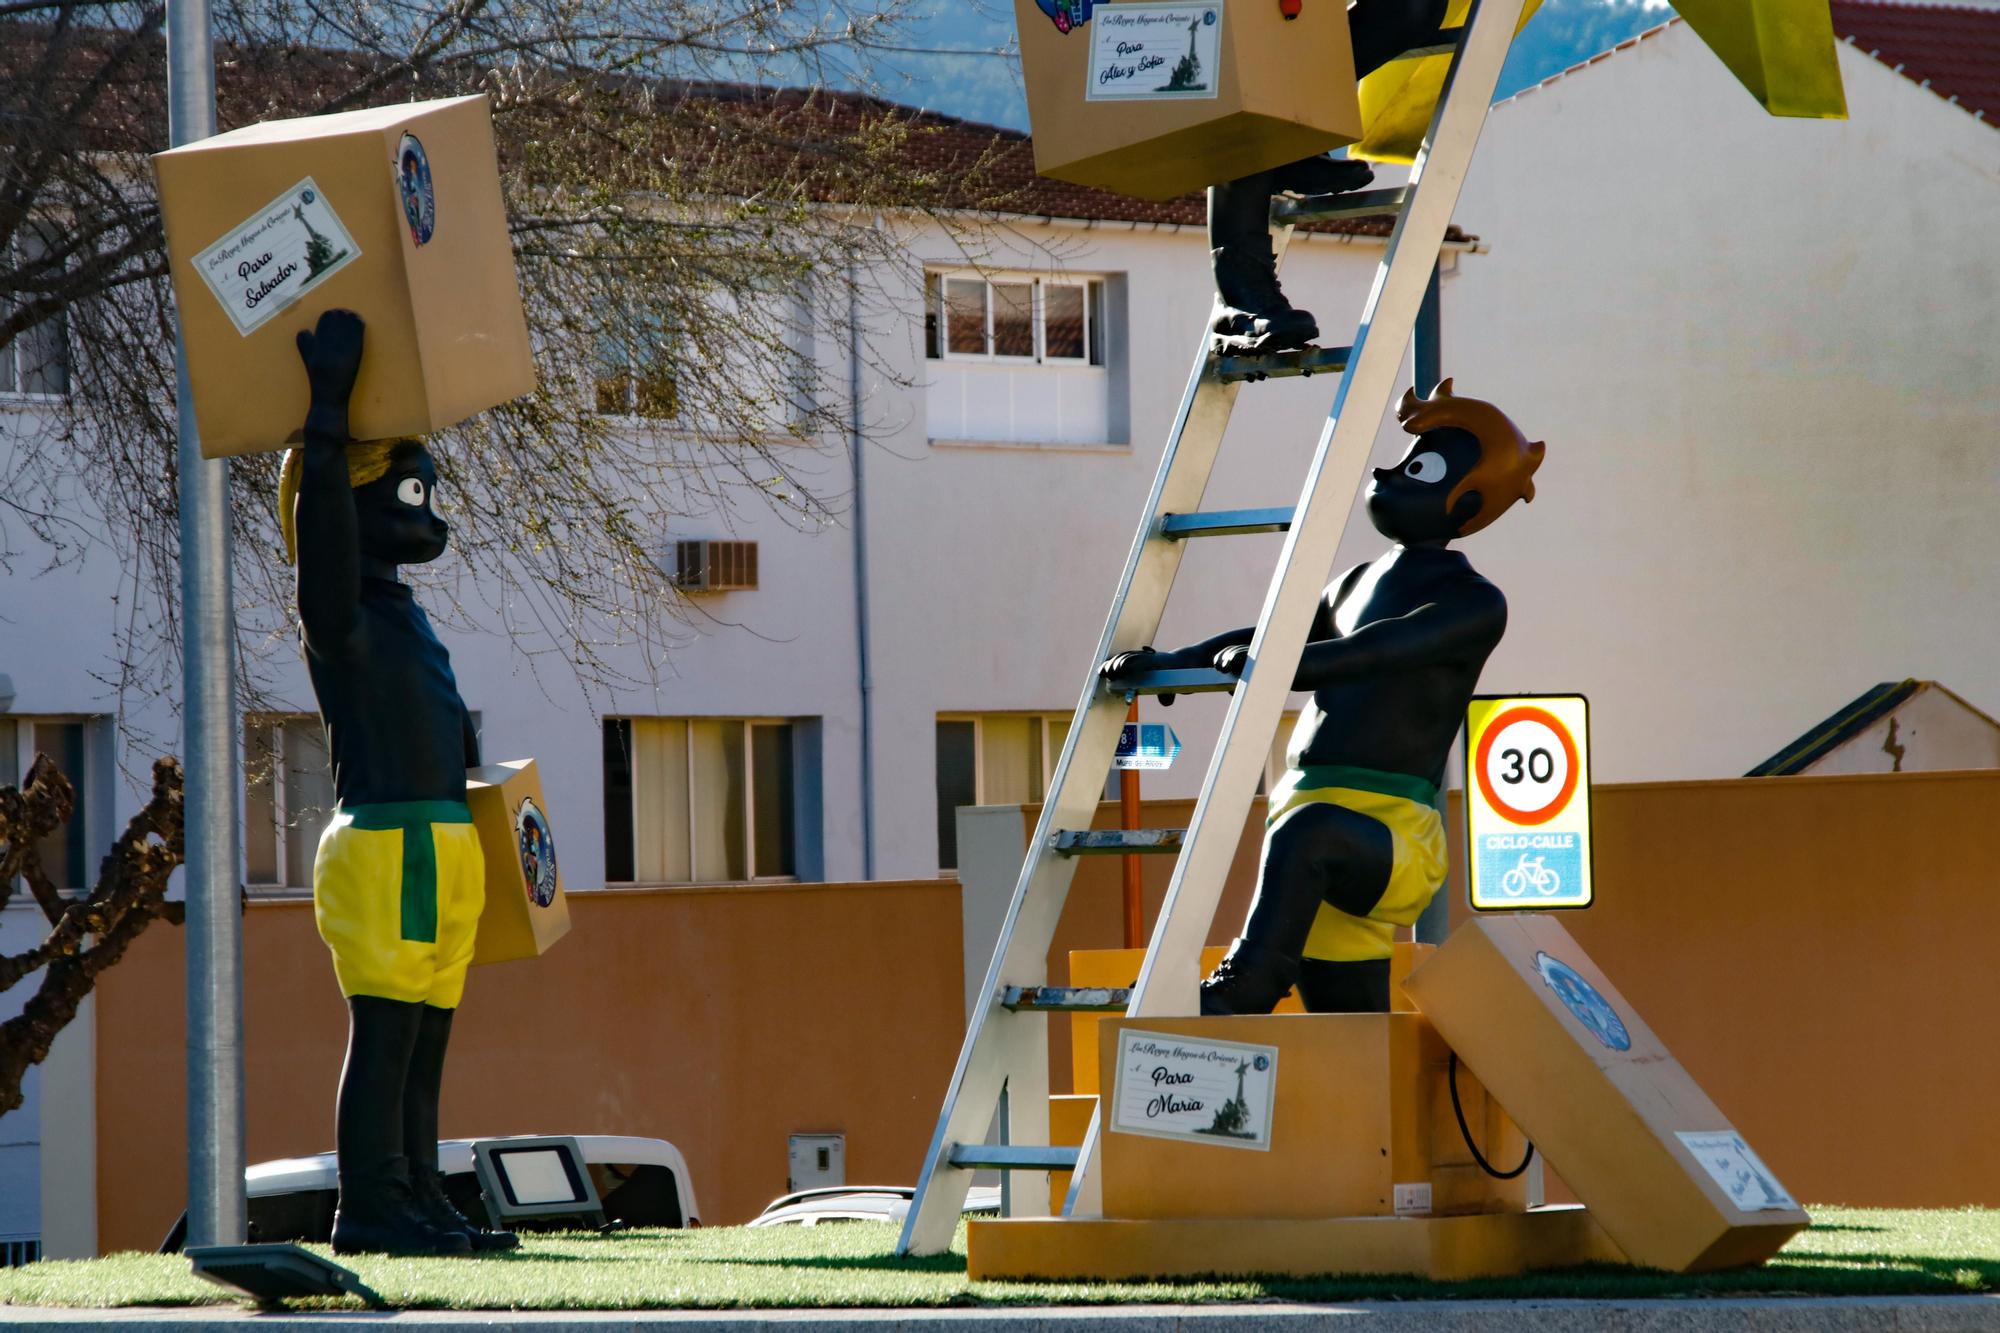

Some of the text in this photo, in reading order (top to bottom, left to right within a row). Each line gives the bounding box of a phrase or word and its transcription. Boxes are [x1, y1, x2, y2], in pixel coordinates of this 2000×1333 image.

[1116, 42, 1144, 57] Para
[1127, 65, 1136, 79] y
[238, 252, 273, 281] Para
[246, 262, 298, 309] Salvador
[1501, 747, 1554, 784] 30
[1486, 835, 1574, 850] CICLO-CALLE
[1151, 1066, 1195, 1087] Para
